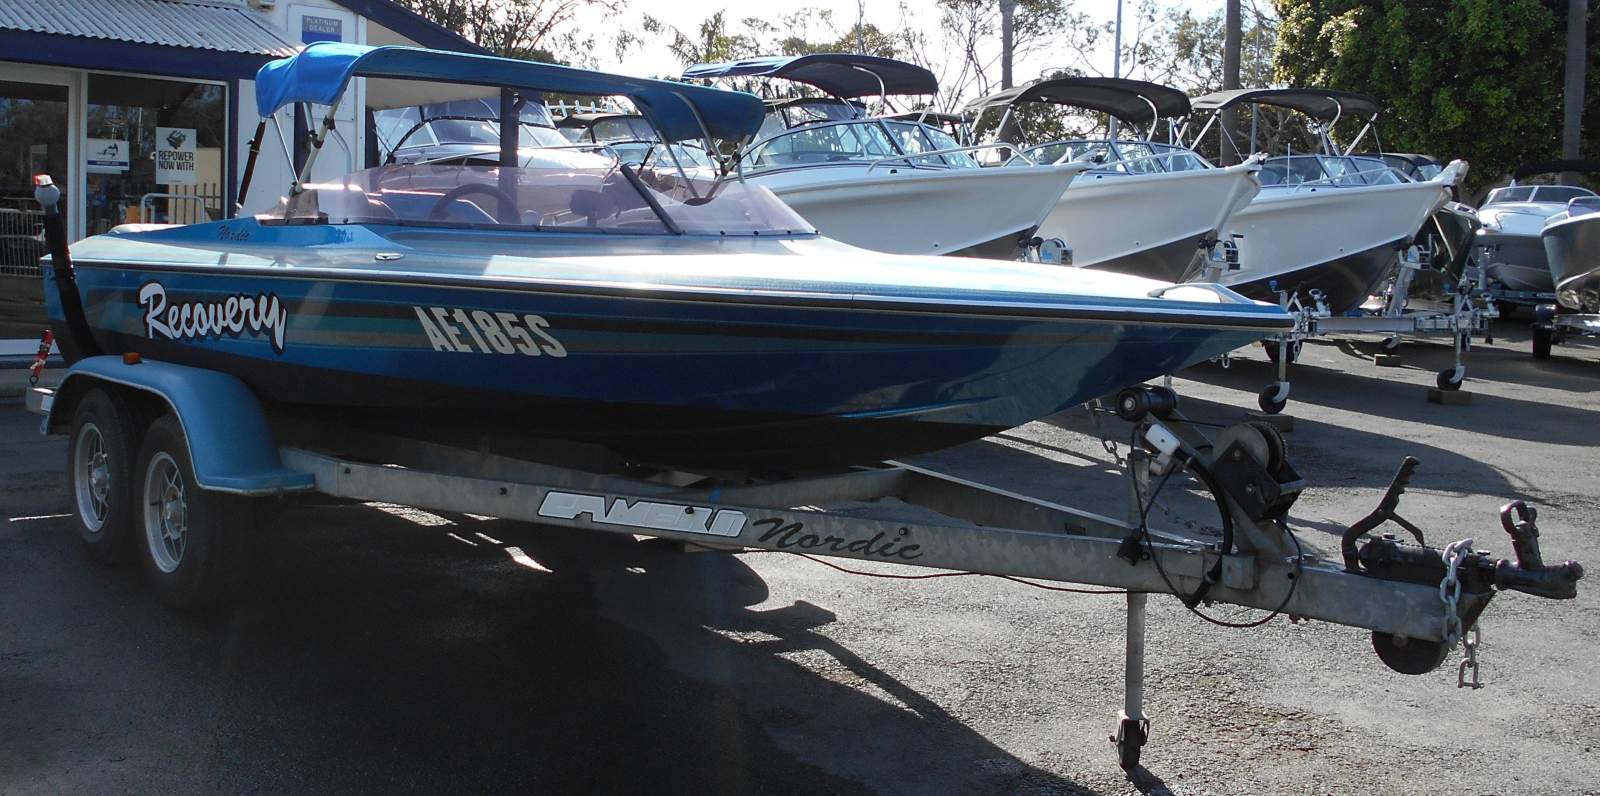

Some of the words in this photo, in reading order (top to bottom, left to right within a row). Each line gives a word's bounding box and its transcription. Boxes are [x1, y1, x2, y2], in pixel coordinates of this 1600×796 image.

[305, 15, 340, 26] PLATINUM
[308, 24, 336, 33] DEALER
[158, 150, 194, 161] REPOWER
[158, 161, 175, 170] NOW
[176, 161, 194, 171] WITH
[138, 281, 287, 352] Recovery
[413, 305, 568, 358] AE185S
[753, 516, 923, 561] Nordic
